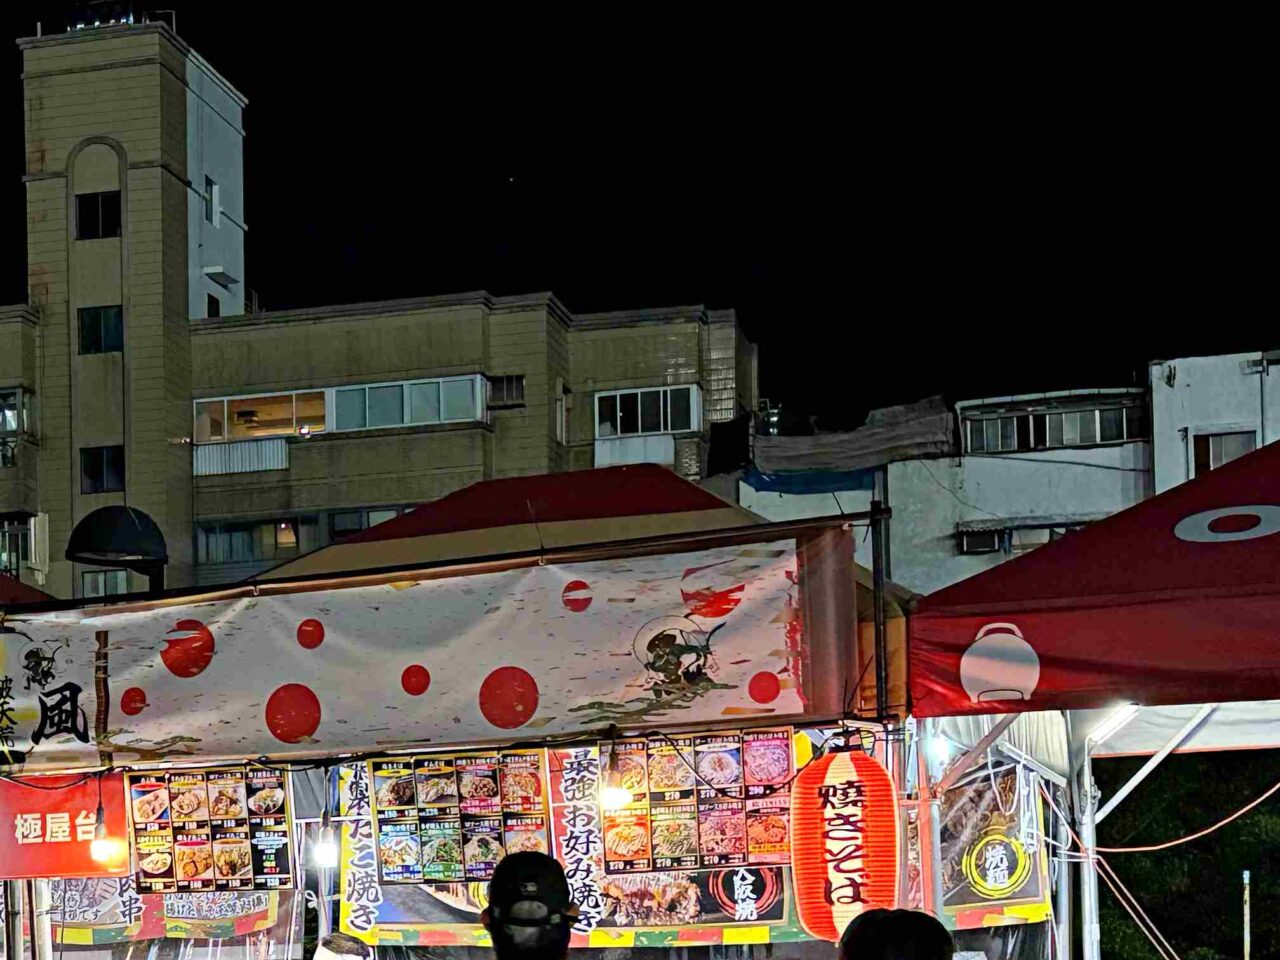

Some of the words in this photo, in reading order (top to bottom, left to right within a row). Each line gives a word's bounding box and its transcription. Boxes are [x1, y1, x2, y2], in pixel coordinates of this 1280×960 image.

[31, 682, 91, 744] 風
[14, 810, 98, 845] 極屋台
